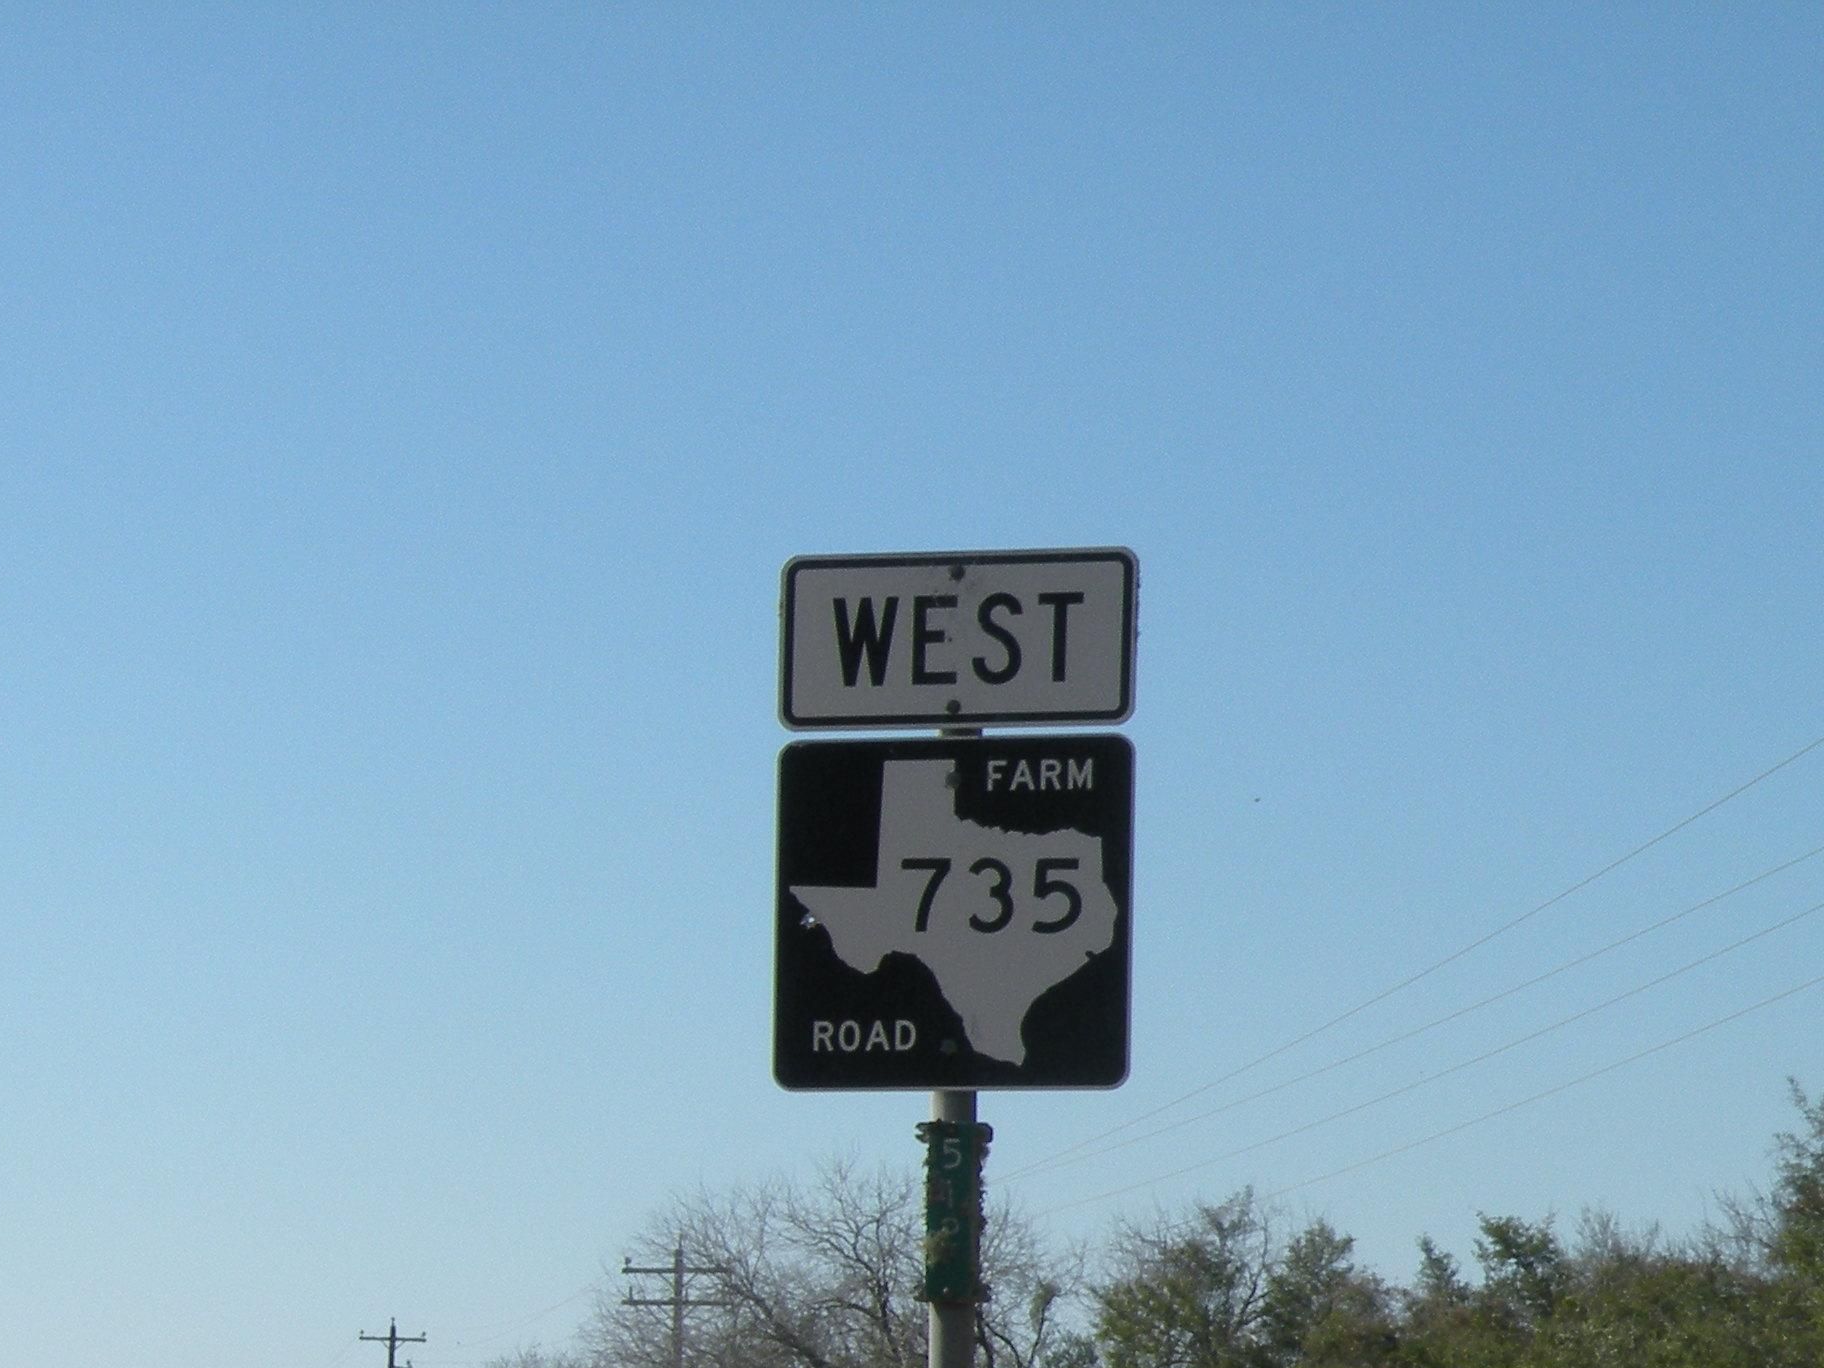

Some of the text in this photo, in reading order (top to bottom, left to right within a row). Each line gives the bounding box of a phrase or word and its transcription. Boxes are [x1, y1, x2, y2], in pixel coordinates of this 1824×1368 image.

[832, 591, 1085, 687] WEST
[986, 757, 1094, 791] FARM
[901, 857, 1083, 934] 735
[812, 1019, 917, 1052] ROAD
